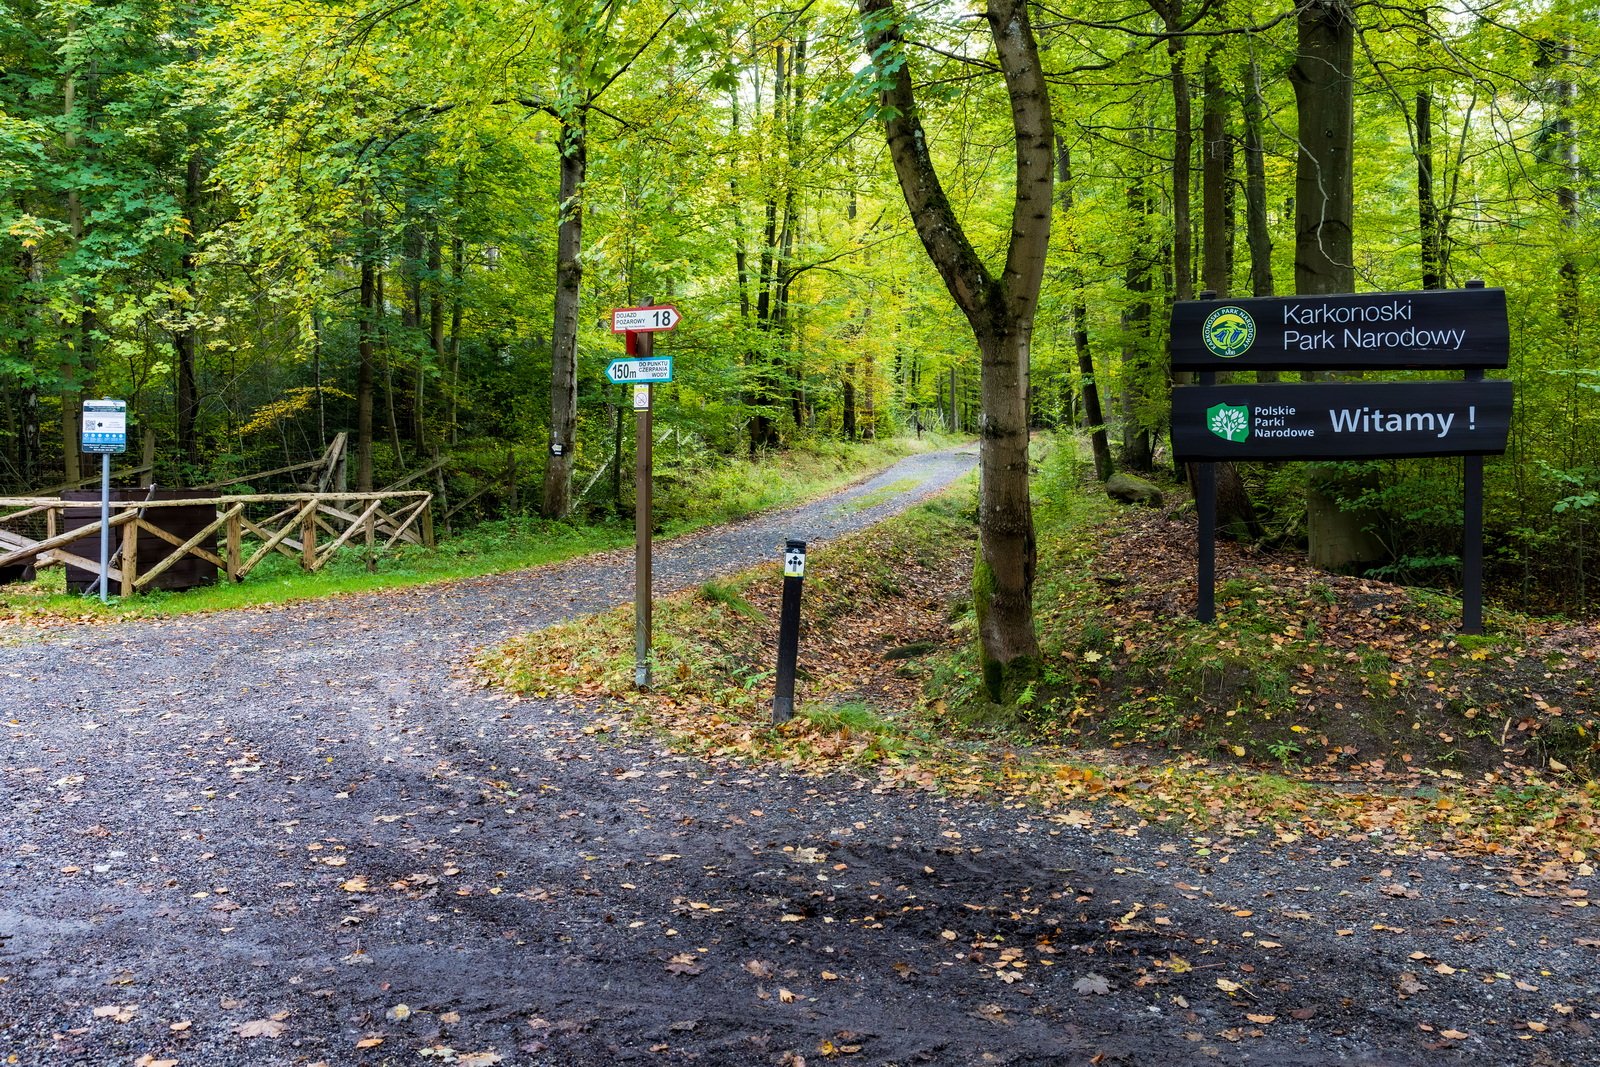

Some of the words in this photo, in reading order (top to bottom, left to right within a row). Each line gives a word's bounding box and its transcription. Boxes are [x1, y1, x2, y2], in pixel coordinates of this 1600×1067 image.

[652, 310, 671, 327] 18
[1283, 299, 1412, 324] Karkonoski
[1204, 311, 1221, 350] KARKONOSKI
[1239, 311, 1254, 348] NARODOWY
[1283, 329, 1336, 350] Park
[1343, 326, 1466, 350] Narodowy
[1254, 405, 1296, 416] Polskie
[1254, 416, 1285, 427] Parki
[1329, 406, 1455, 438] Witamy
[1254, 428, 1315, 438] Narodowe
